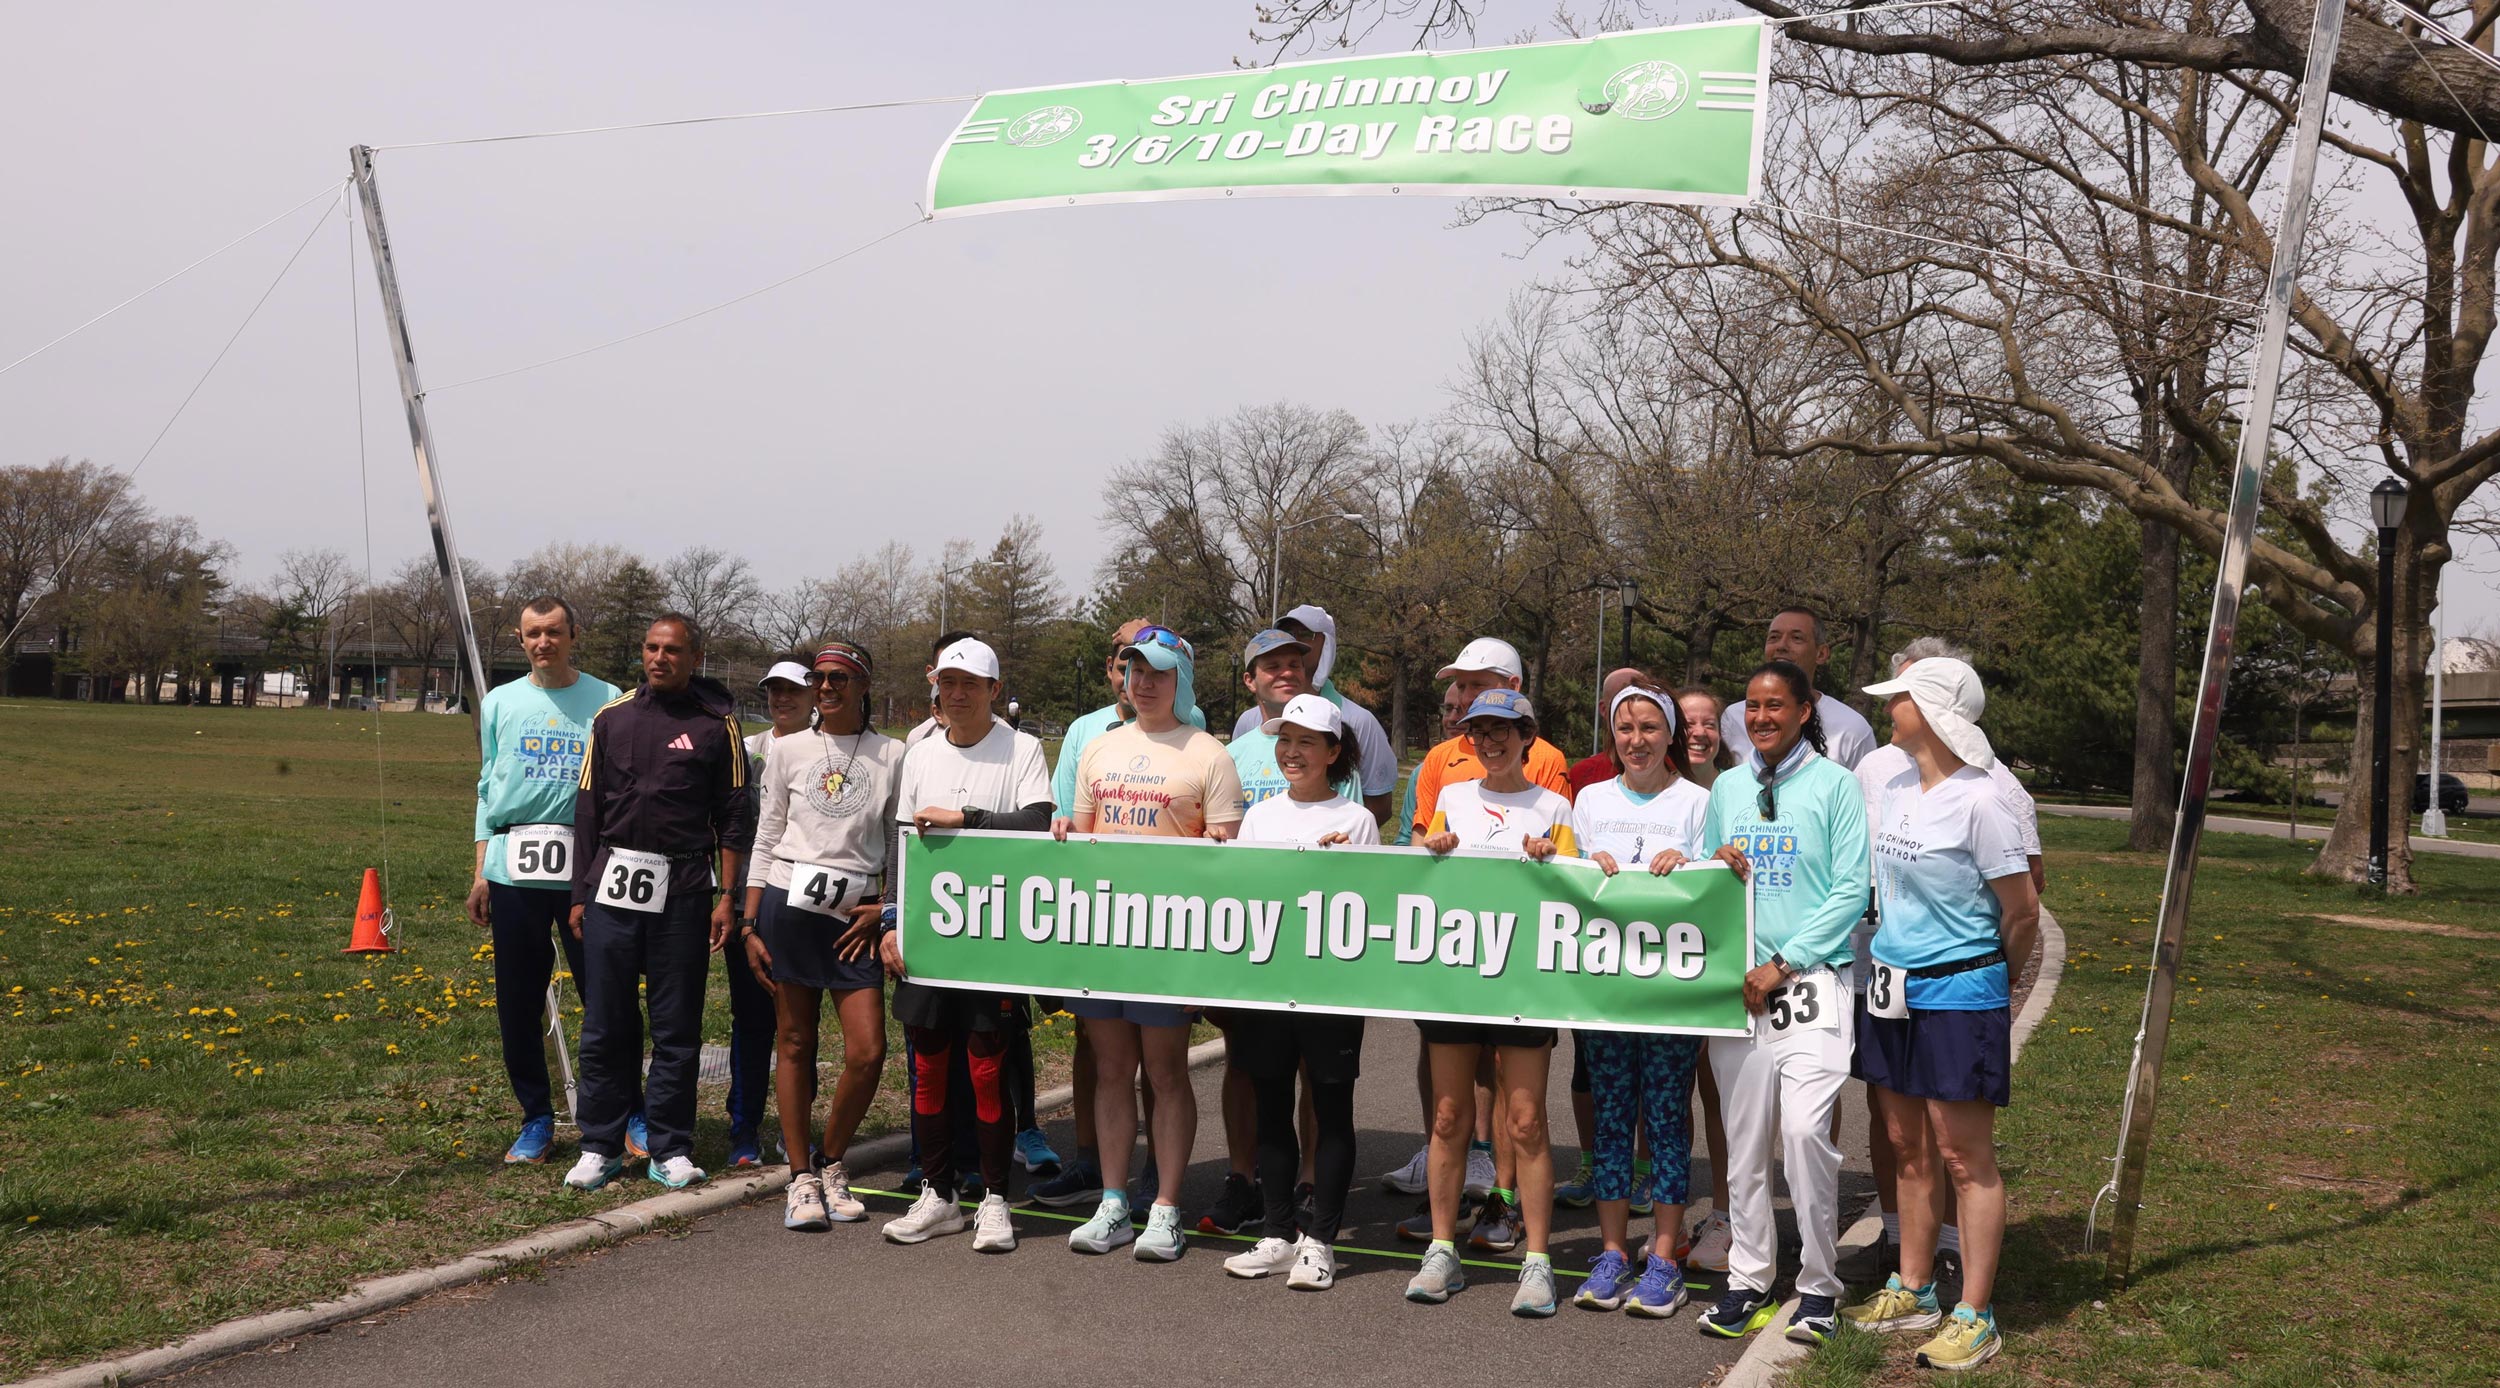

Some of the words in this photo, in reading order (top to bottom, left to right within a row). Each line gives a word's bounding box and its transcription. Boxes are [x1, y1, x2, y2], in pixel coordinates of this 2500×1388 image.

[1150, 92, 1237, 126] Sri
[1251, 69, 1510, 119] Chinmoy
[1078, 120, 1398, 168] 3/6/10-Day
[1413, 114, 1573, 154] Race
[525, 728, 538, 736] SRI
[540, 729, 581, 739] CHINMOY
[525, 738, 541, 751] 10
[551, 740, 560, 752] 6
[572, 741, 581, 753] 3
[538, 753, 568, 766] DAY
[525, 766, 580, 781] RACES
[1105, 772, 1121, 782] SRI
[1124, 773, 1167, 785] CHINMOY
[1090, 779, 1172, 809] Thanksgiving
[1243, 790, 1254, 802] 0
[1609, 821, 1648, 834] Chinmoy
[1648, 822, 1677, 837] Races
[1734, 825, 1747, 834] SRI
[1750, 825, 1794, 834] CHINMOY
[1733, 836, 1749, 851] 10
[1759, 837, 1769, 852] 6
[1782, 837, 1793, 852] 3
[1877, 832, 1887, 841] RI
[1886, 833, 1924, 851] CHINMOY
[518, 840, 566, 874] 50
[644, 858, 666, 866] RACES
[607, 864, 655, 904] 36
[1755, 871, 1793, 887] CES
[803, 872, 849, 910] 41
[929, 871, 1007, 940] Sri
[1019, 875, 1284, 964] Chinmoy
[1297, 890, 1518, 977] 10-Day
[1536, 900, 1706, 981] Race
[1801, 968, 1829, 977] RACES
[1767, 981, 1820, 1031] 53
